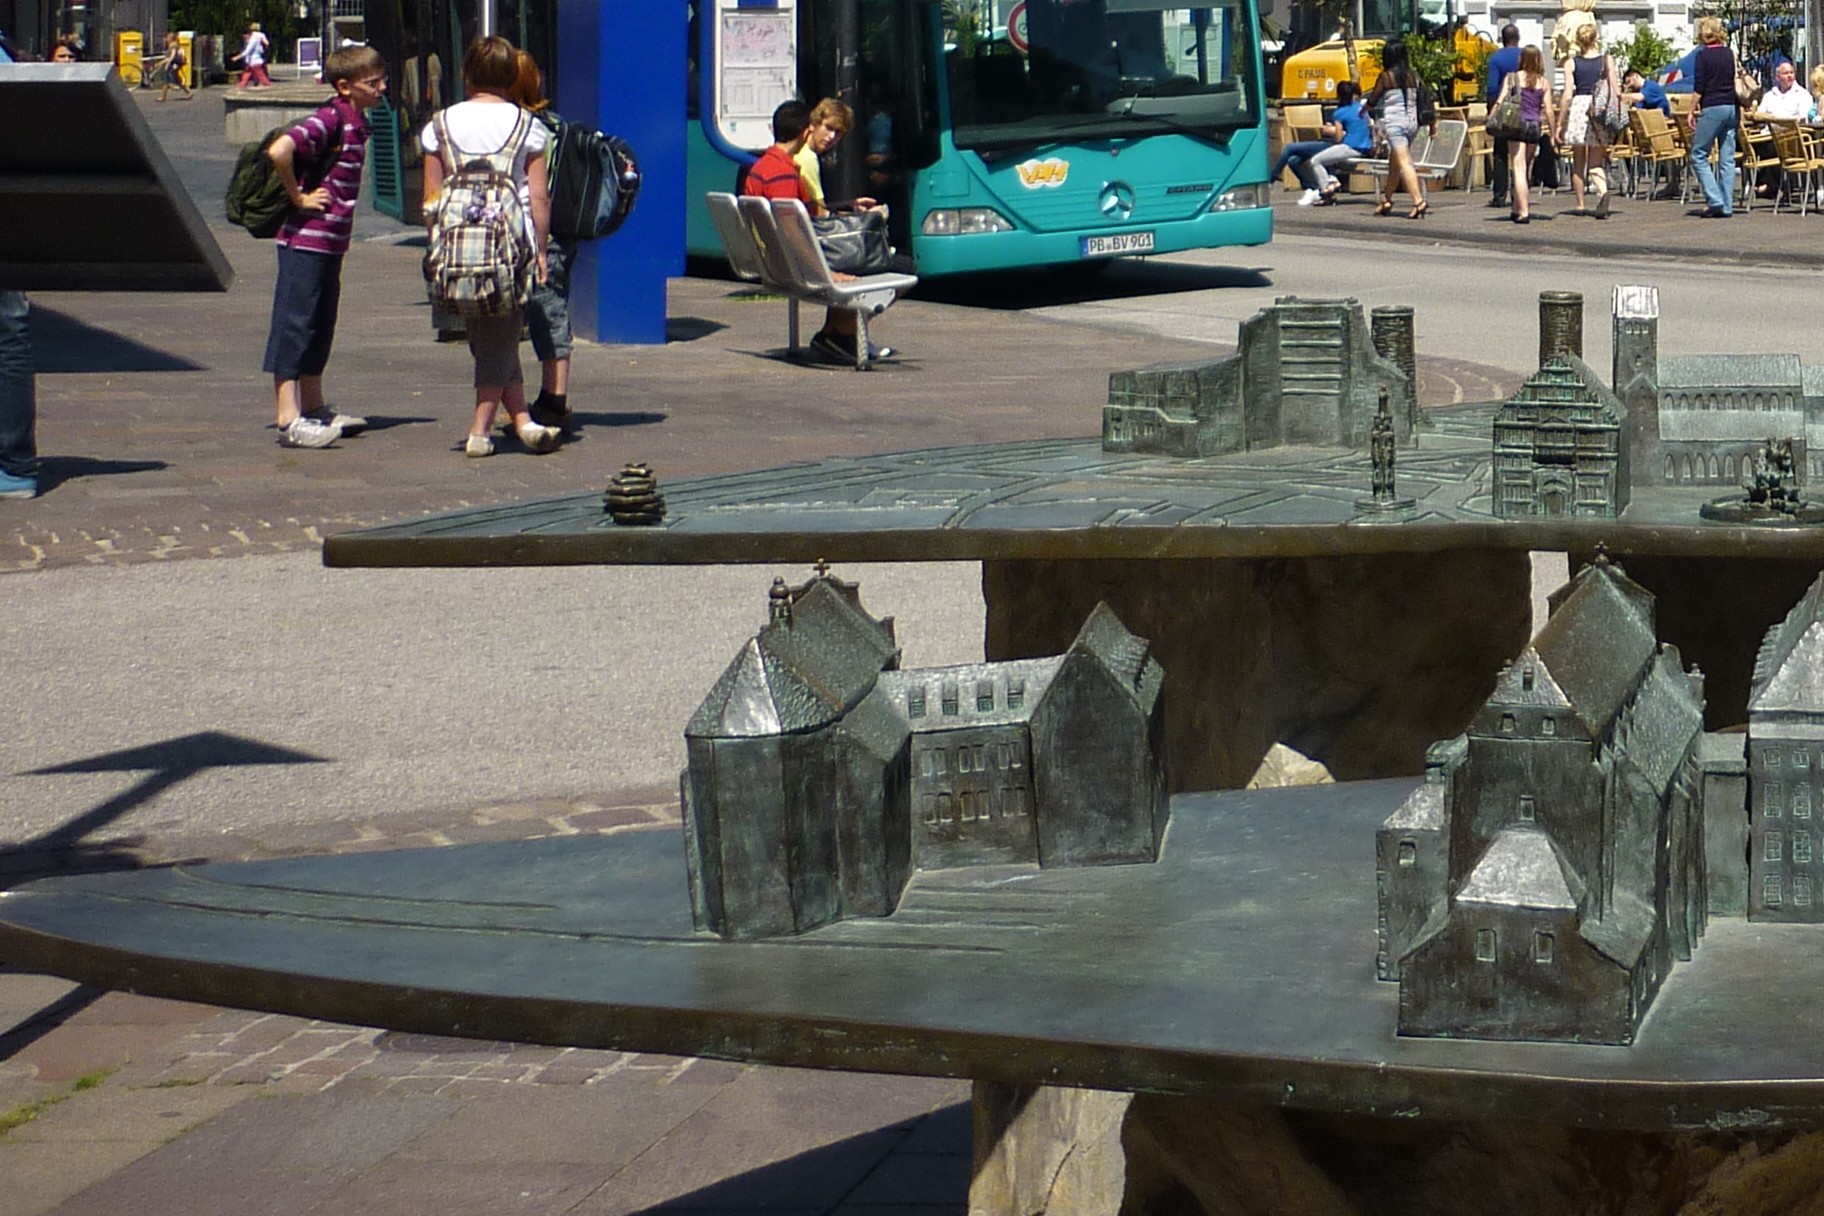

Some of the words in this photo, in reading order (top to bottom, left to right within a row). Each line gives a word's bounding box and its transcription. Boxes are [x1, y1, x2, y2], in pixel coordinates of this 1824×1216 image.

[1090, 238, 1105, 252] PB
[1113, 236, 1128, 250] BV
[1130, 234, 1152, 248] 901
